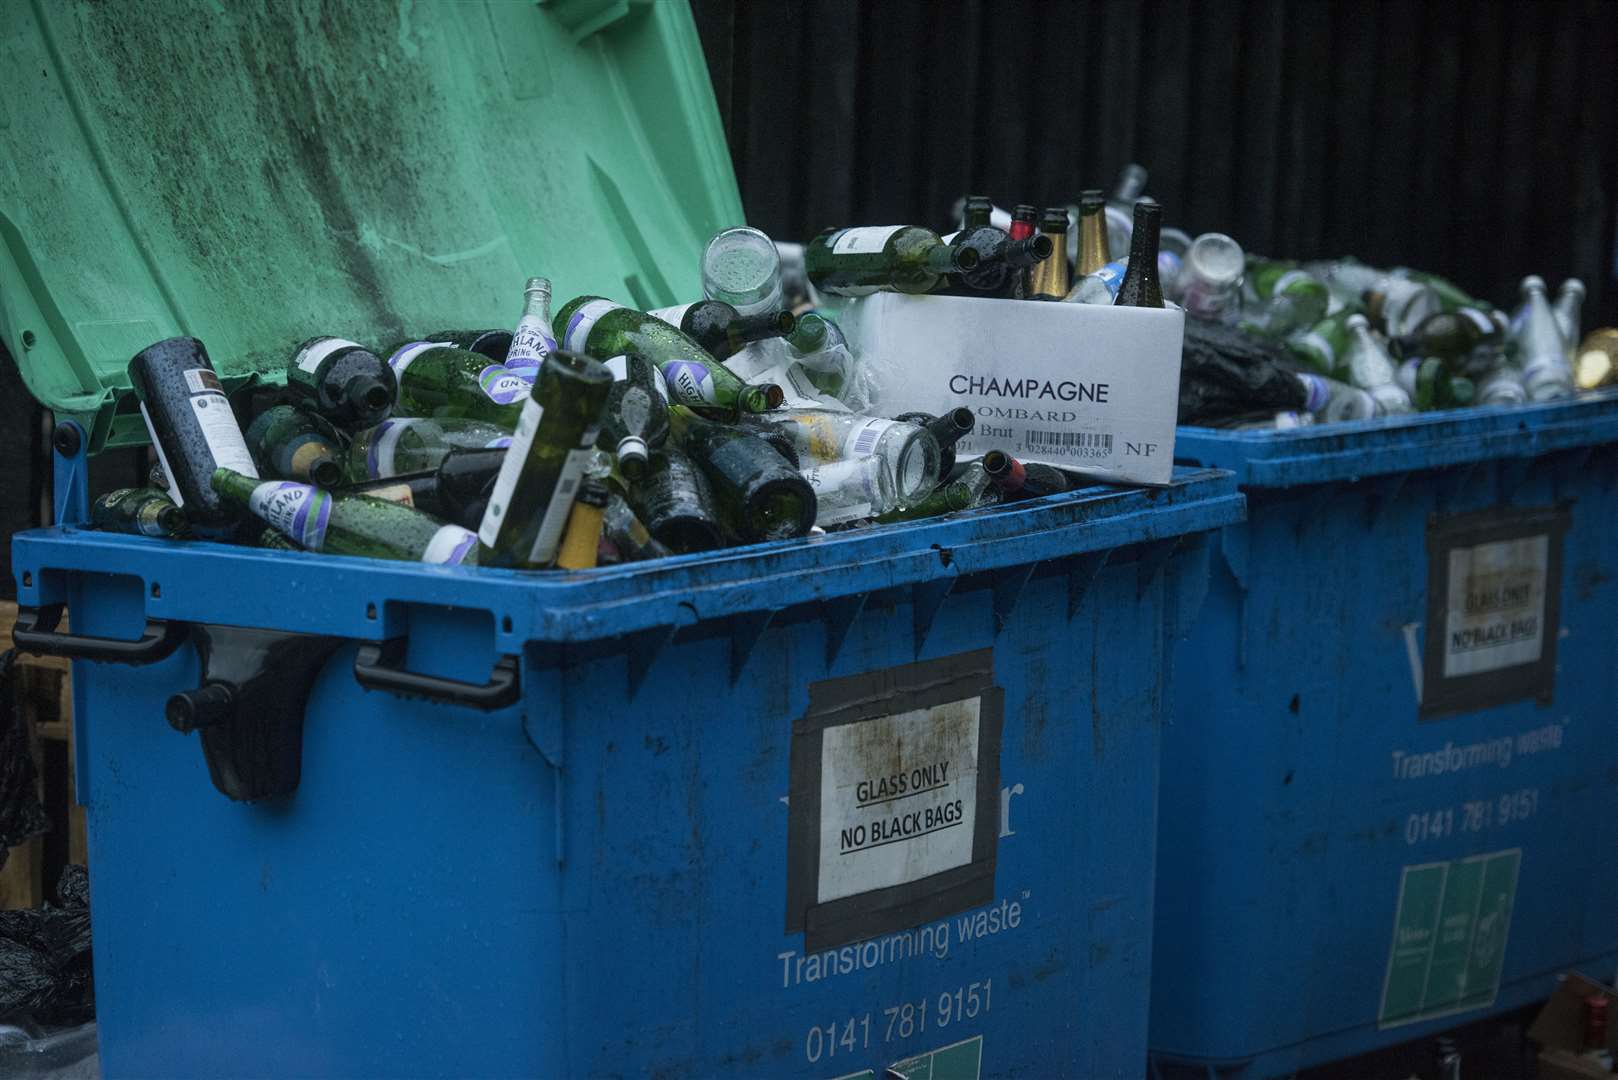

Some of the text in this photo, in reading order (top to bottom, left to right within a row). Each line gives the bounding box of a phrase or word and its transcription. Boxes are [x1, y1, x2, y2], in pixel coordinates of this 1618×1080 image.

[949, 374, 1110, 403] CHAMPAGNE
[964, 405, 1077, 422] OMBARD
[980, 424, 1013, 438] Brut
[1124, 442, 1158, 457] NF
[1392, 735, 1513, 780] Transforming
[857, 761, 950, 803] GLASS ONLY
[841, 800, 963, 850] NO BLACK BAGS
[1406, 806, 1453, 846] 0141
[778, 922, 950, 988] Transforming
[957, 898, 1022, 943] waste
[806, 977, 993, 1063] 0141 781 9151
